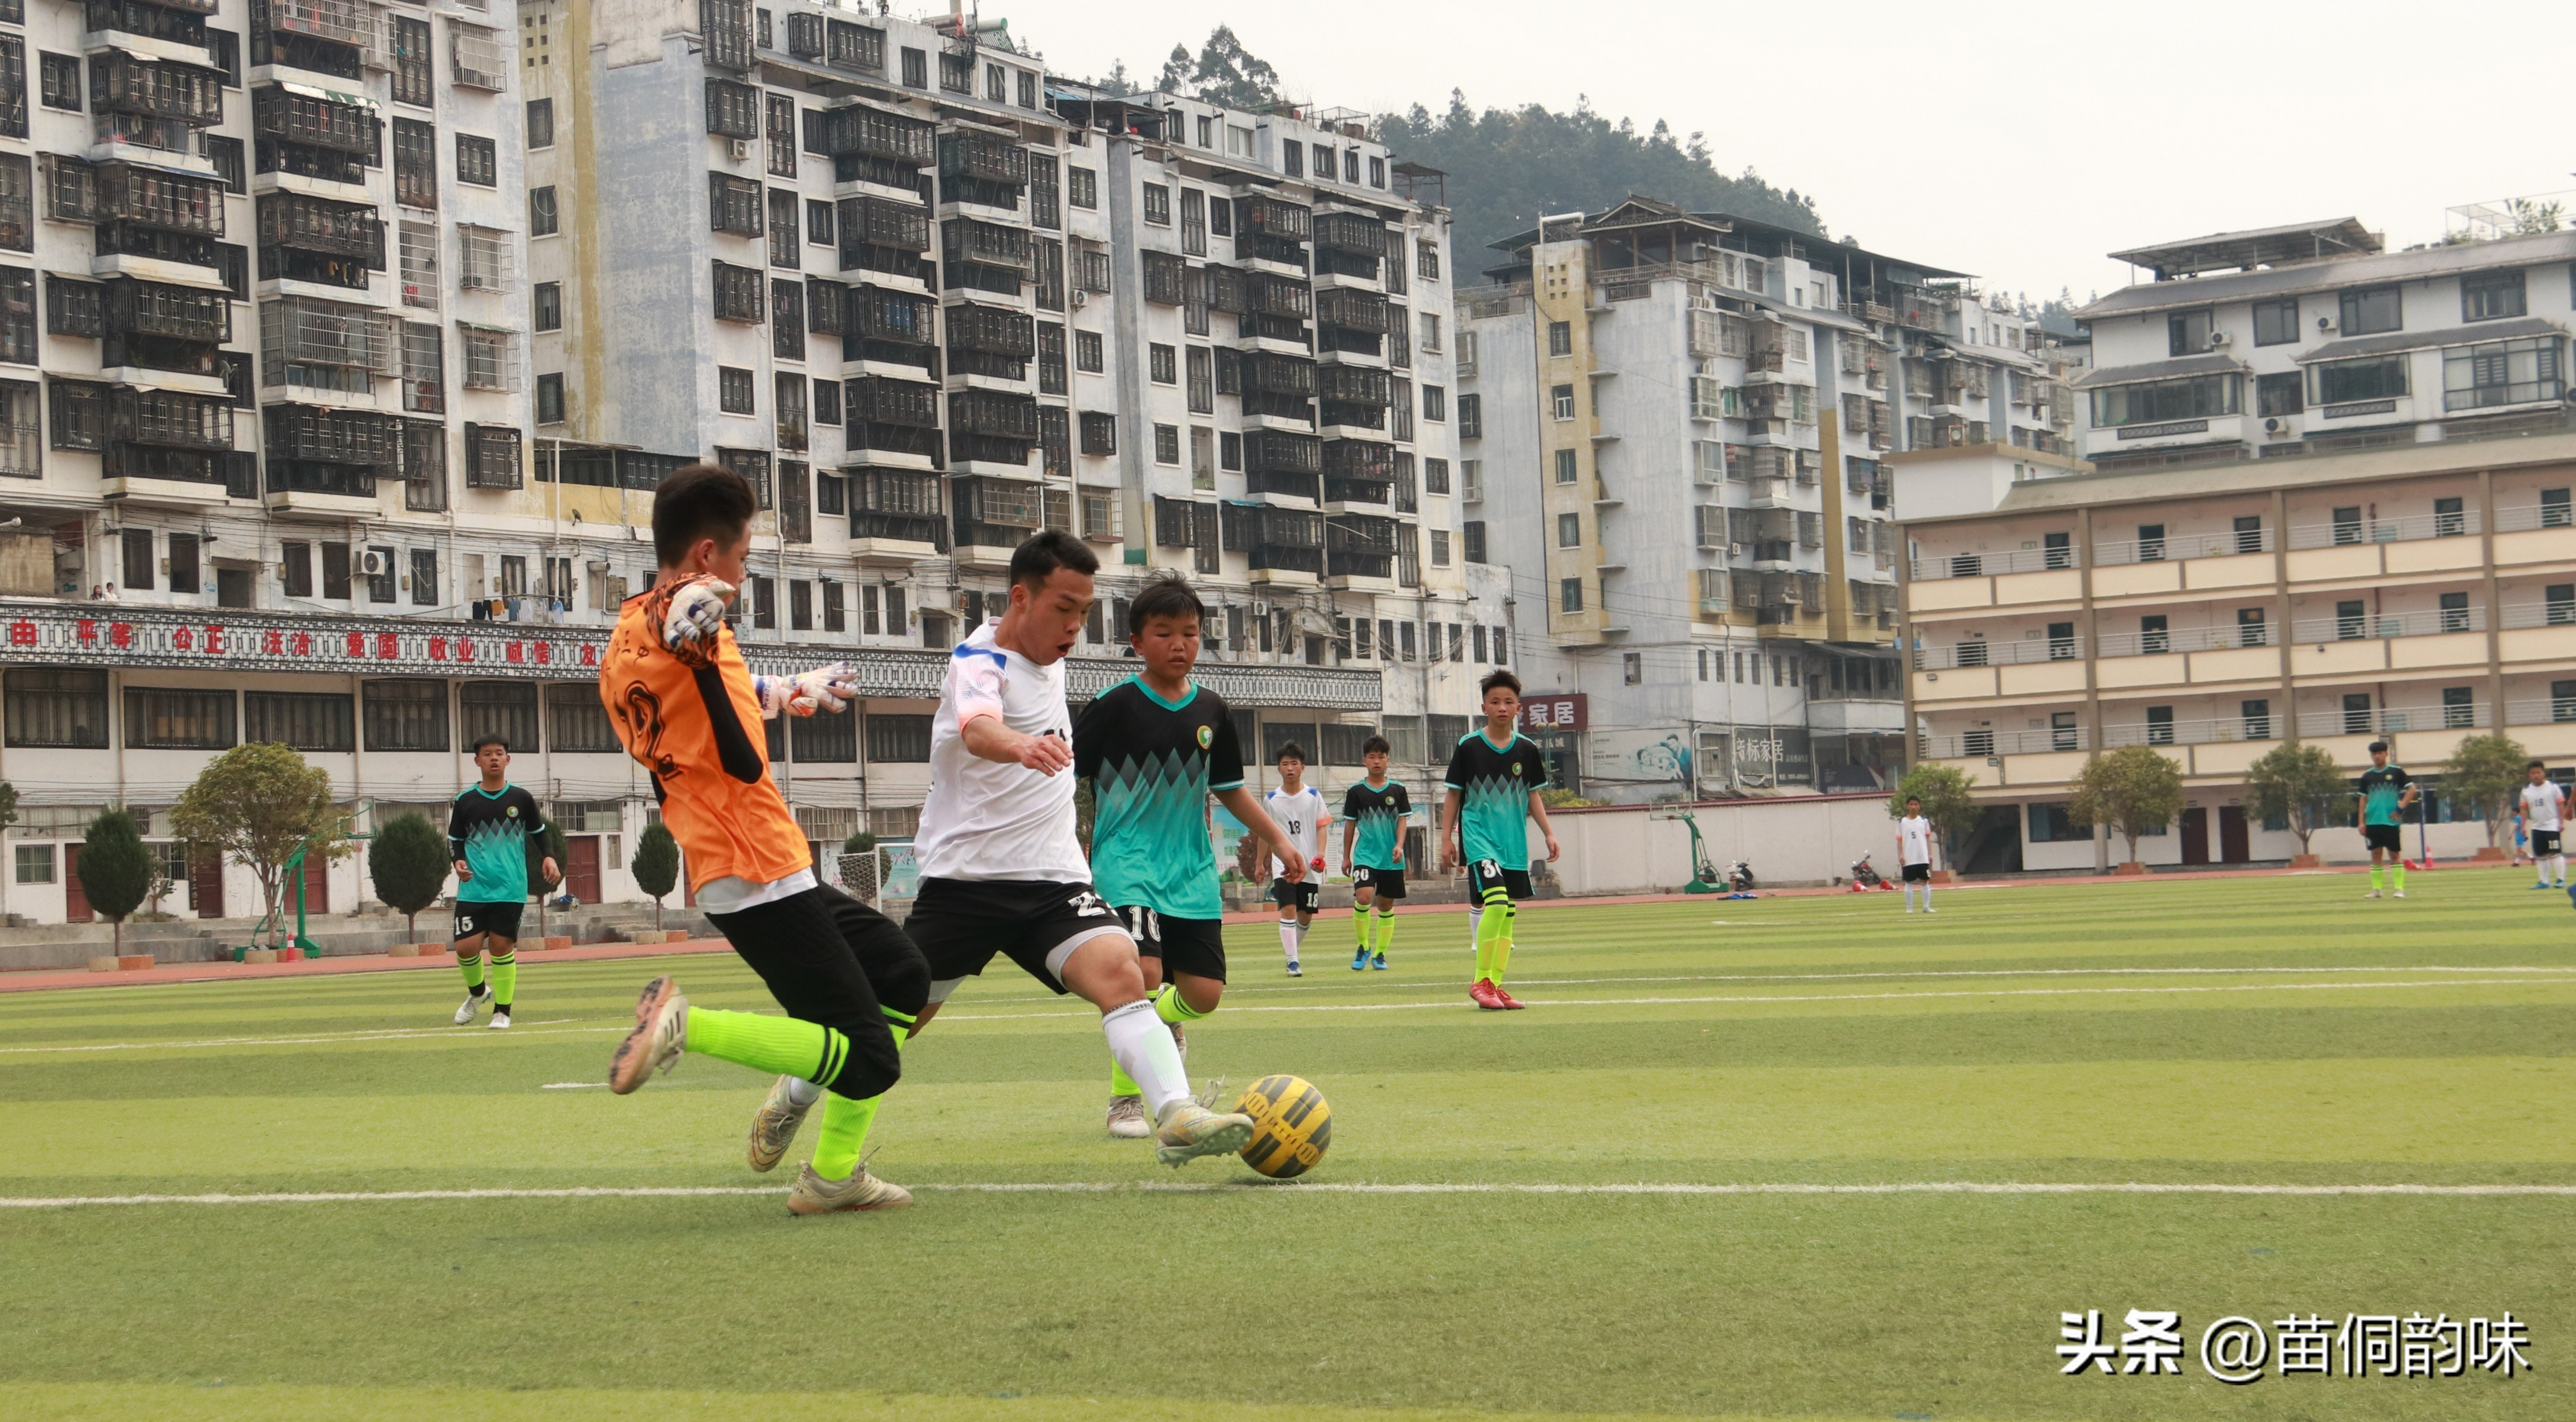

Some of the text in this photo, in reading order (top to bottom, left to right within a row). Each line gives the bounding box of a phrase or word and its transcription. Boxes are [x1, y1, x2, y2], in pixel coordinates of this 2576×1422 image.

[11, 617, 596, 666] 由 平等 公正 法治 爱国 敬业 诚信 友
[1517, 702, 1574, 725] 家居
[1288, 820, 1301, 834] 18
[1353, 868, 1369, 884] 20
[1306, 892, 1319, 908] 18
[455, 916, 474, 935] 15
